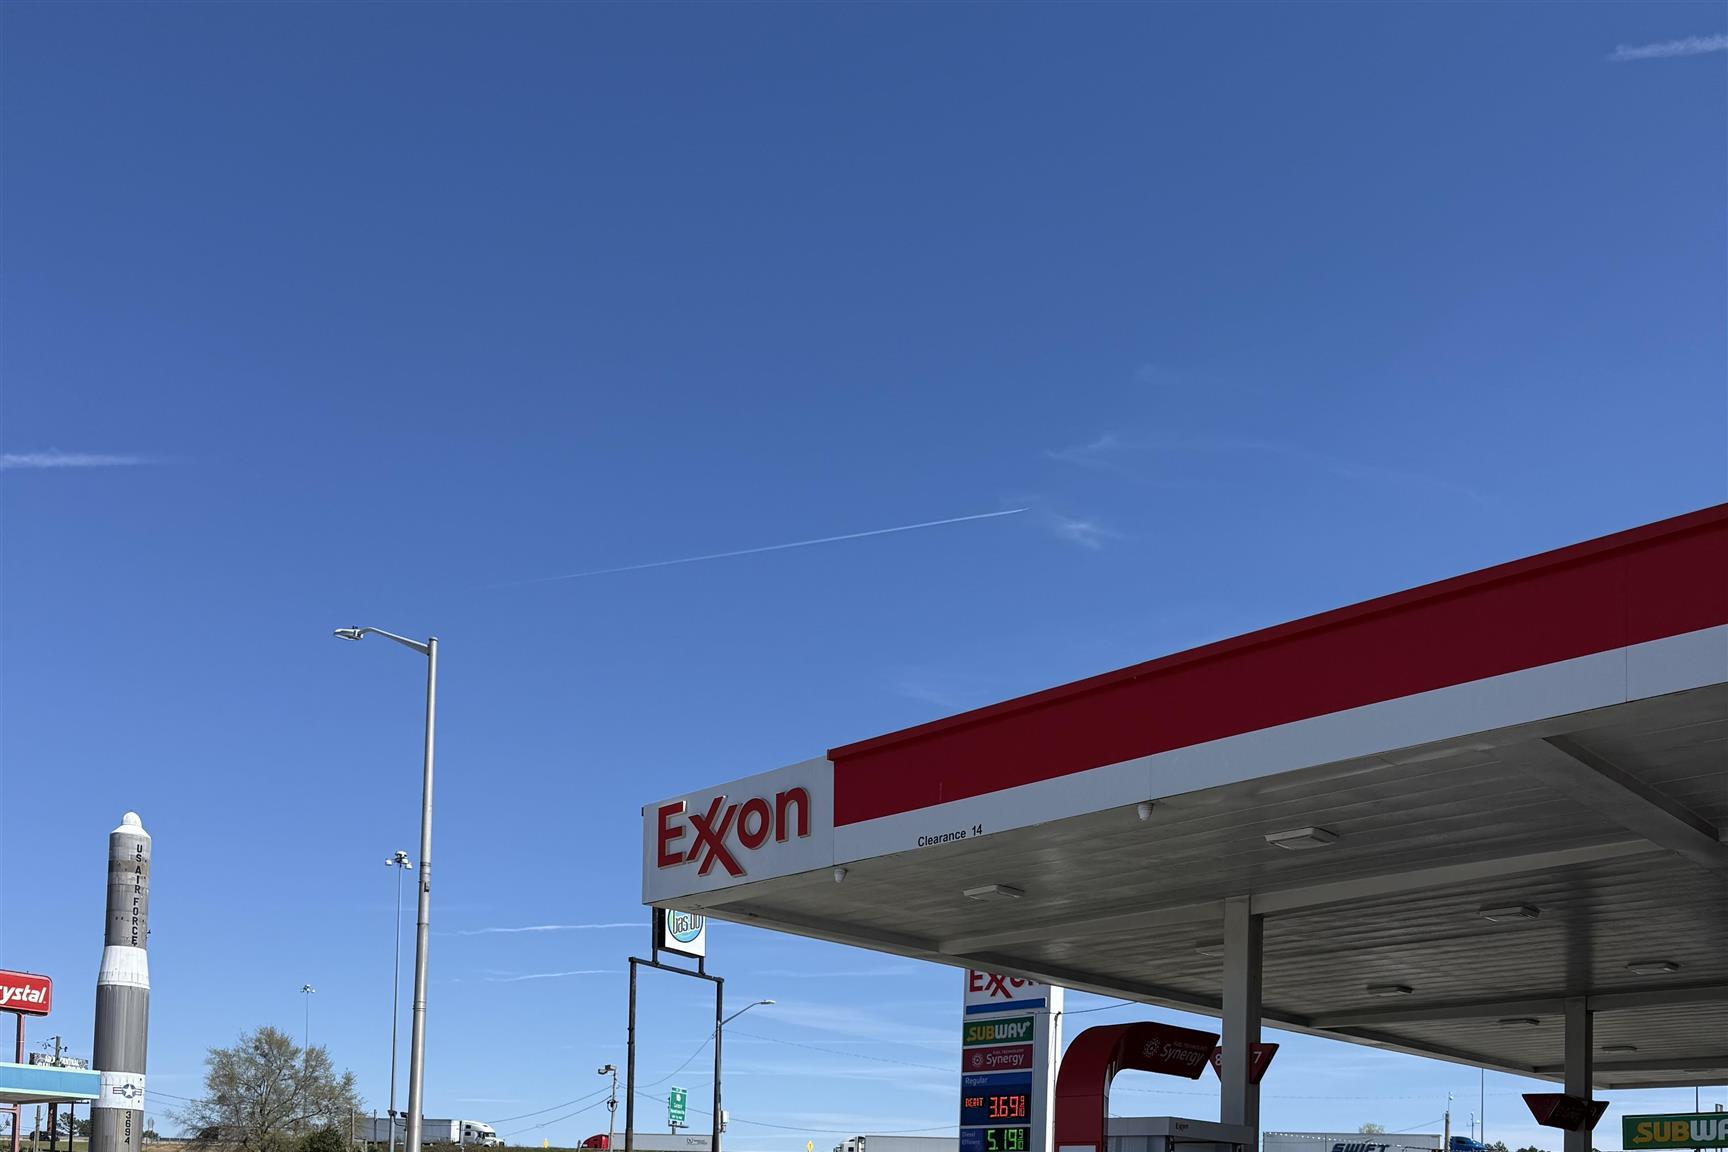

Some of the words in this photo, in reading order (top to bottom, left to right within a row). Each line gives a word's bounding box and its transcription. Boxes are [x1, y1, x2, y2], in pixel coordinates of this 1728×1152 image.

[657, 786, 812, 878] Exxon
[917, 829, 967, 847] Clearance
[971, 823, 983, 837] 14
[134, 865, 142, 894] AIR
[131, 897, 140, 946] FORCE
[967, 1021, 1031, 1041] SUBWAY
[986, 1053, 1025, 1067] Synergy
[1160, 1043, 1204, 1066] Synergy
[1253, 1051, 1262, 1064] 7
[965, 1077, 988, 1086] Regular
[965, 1097, 984, 1107] DEBIT
[124, 1110, 132, 1145] 3694
